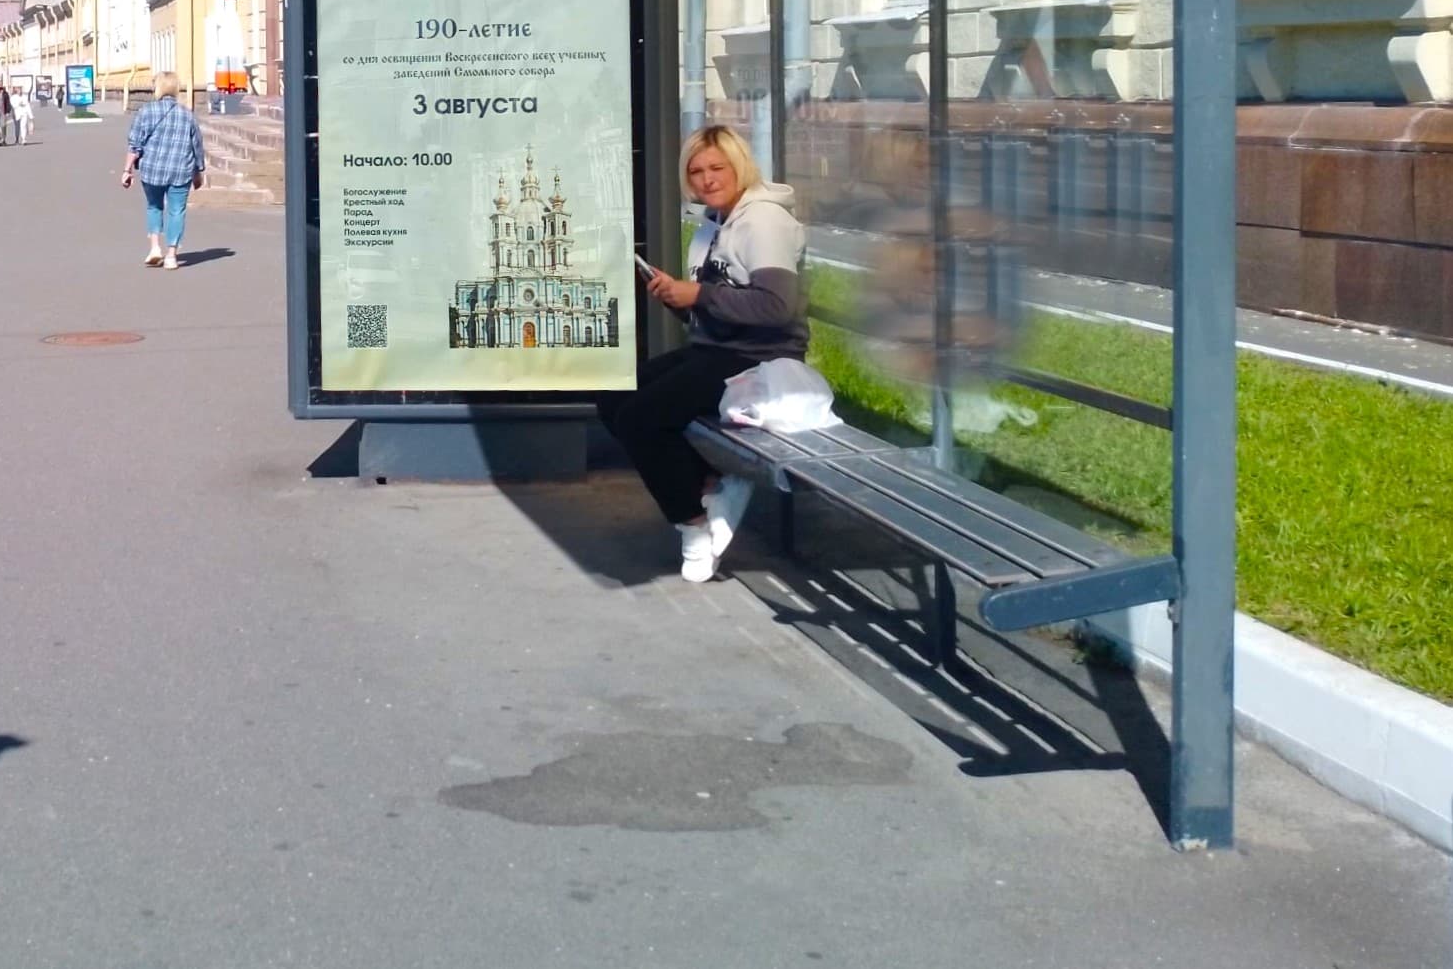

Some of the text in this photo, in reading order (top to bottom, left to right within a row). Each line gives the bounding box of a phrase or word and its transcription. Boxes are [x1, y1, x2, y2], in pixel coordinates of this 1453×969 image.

[357, 54, 378, 65] дня
[558, 50, 607, 63] учебных
[454, 66, 516, 77] Смольного
[413, 94, 538, 118] 3 августа
[343, 152, 452, 167] Начало: 10.00
[343, 188, 408, 197] Богослужение
[343, 198, 405, 207] Крестный ход
[344, 208, 373, 217] Парад
[344, 218, 381, 227] Концерт
[344, 228, 408, 237] Полевая кухня
[344, 238, 394, 247] Экскурсии
